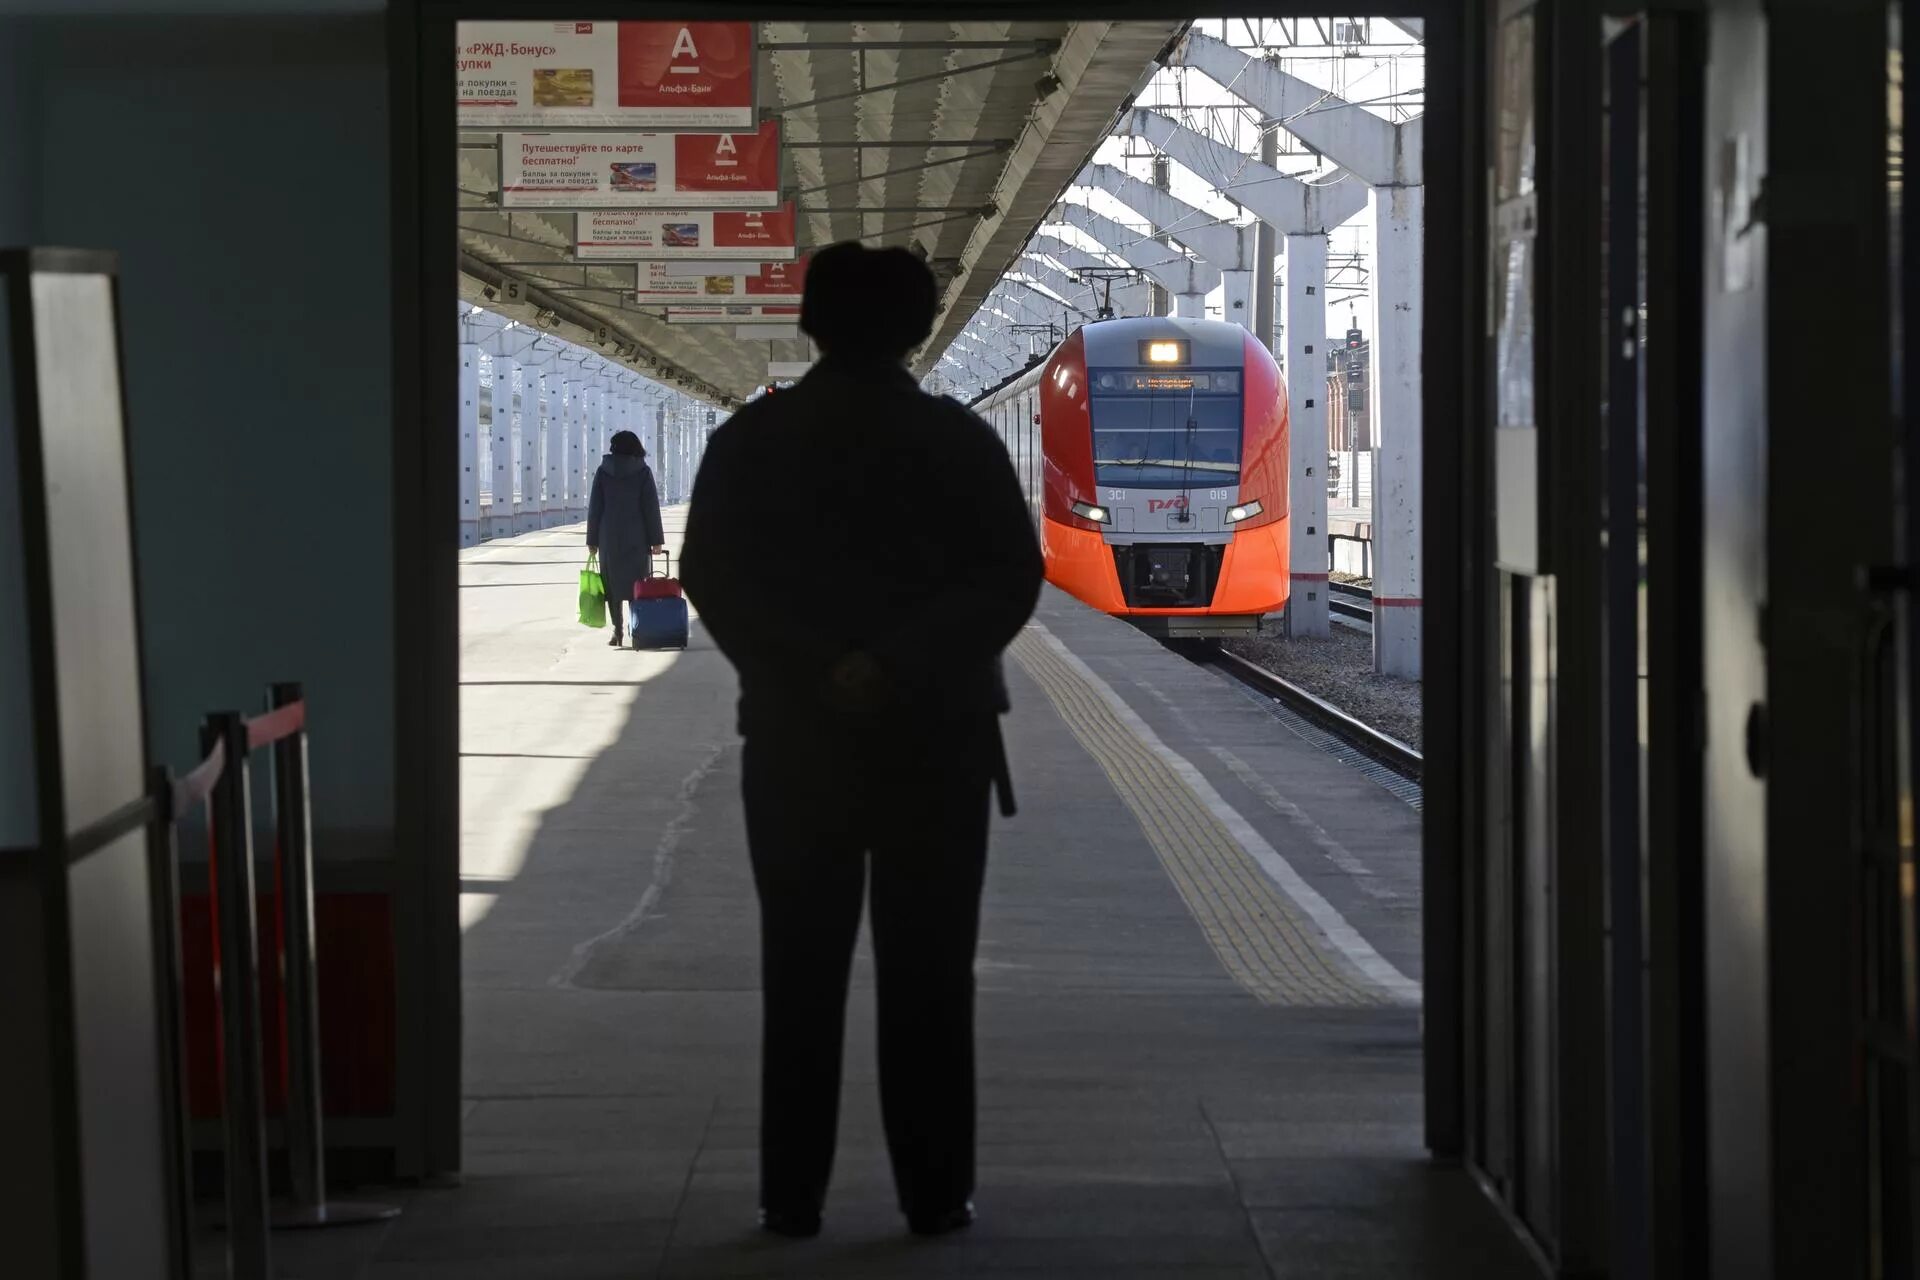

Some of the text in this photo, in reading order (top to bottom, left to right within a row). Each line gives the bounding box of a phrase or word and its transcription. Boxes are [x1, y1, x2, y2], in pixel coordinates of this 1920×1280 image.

[468, 80, 507, 88] покупки
[659, 84, 712, 94] Альфа-Банк
[522, 144, 598, 154] Путешествуйте
[616, 146, 644, 155] карте
[509, 284, 518, 298] 5
[600, 328, 606, 338] 6
[651, 357, 656, 365] 8
[1210, 489, 1227, 500] 019
